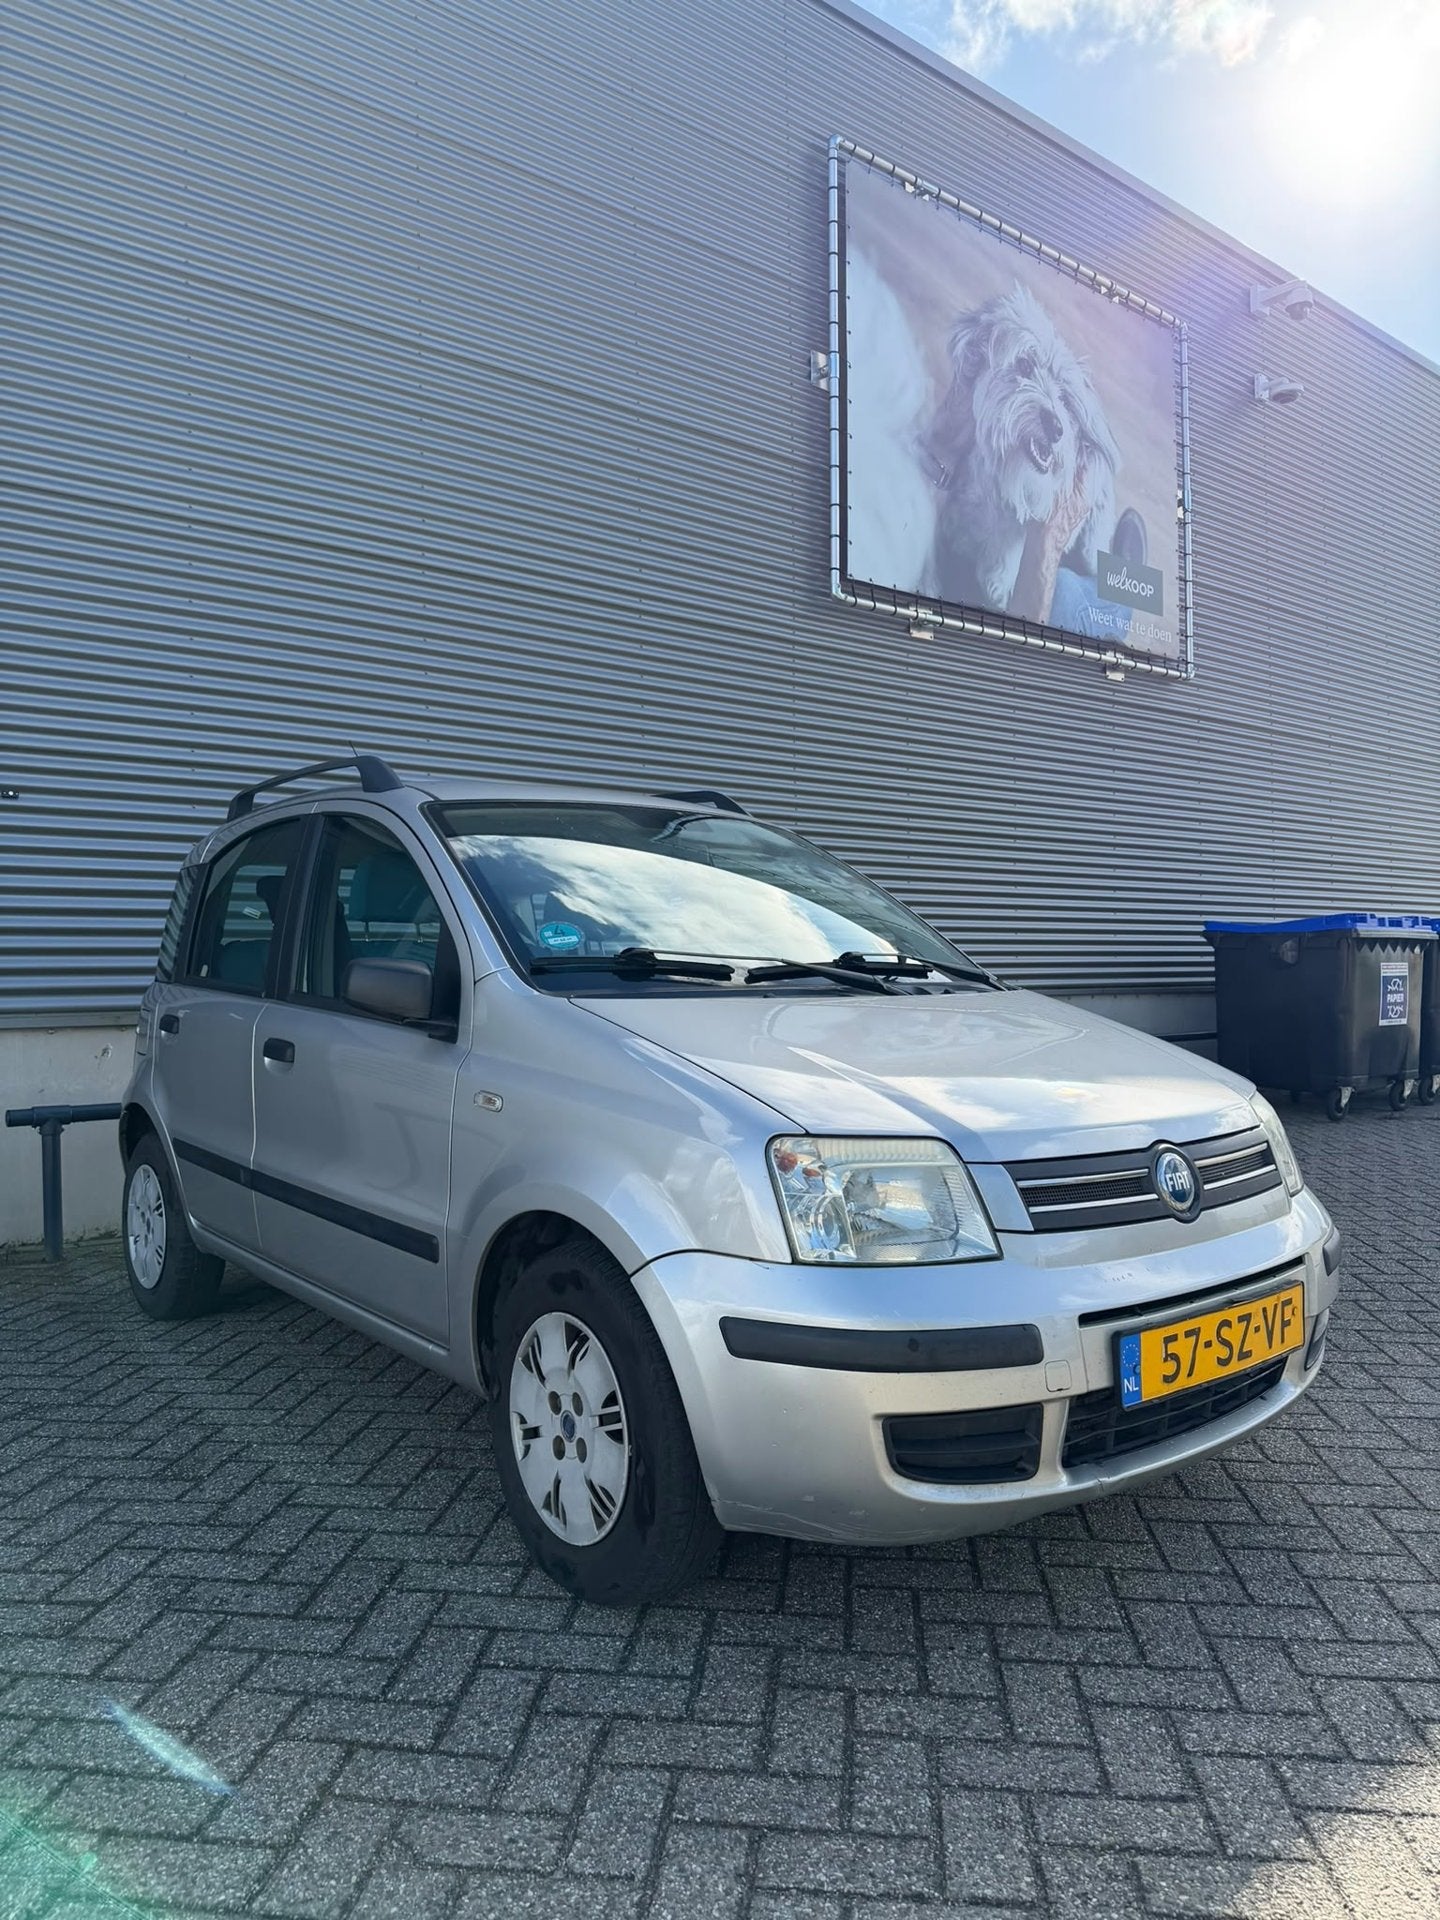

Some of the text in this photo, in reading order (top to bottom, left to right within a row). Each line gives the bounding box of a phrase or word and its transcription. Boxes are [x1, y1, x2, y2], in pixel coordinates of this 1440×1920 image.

[1088, 606, 1172, 643] Weet wat te doen
[1386, 993, 1404, 1003] PAPIER
[1165, 1171, 1190, 1192] FIAT
[1162, 1297, 1293, 1384] 57-SZ-VF
[1123, 1377, 1139, 1394] NL
